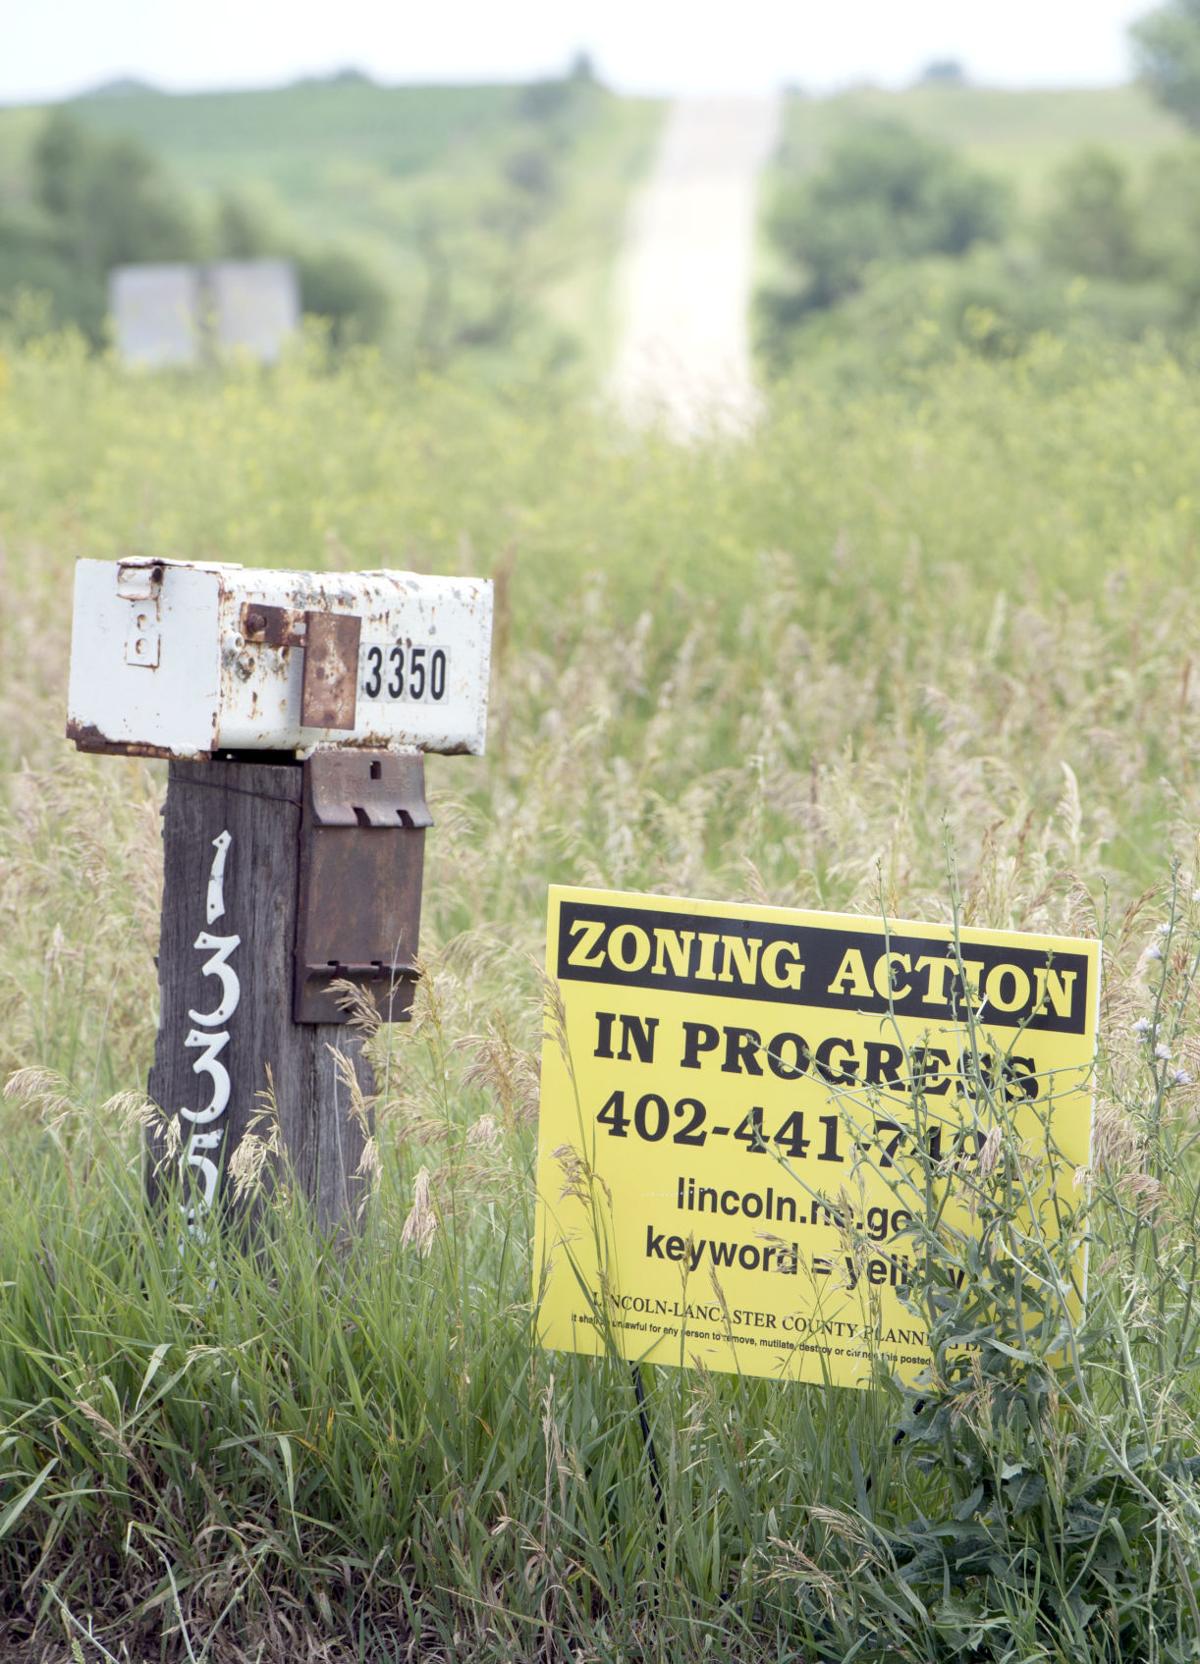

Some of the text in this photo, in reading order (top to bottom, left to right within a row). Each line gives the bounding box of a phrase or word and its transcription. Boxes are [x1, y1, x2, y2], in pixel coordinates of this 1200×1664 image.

[365, 646, 447, 701] 3350
[567, 920, 1078, 1018] ZONING ACTION
[593, 1011, 1040, 1103] IN PROGRESS
[645, 1225, 799, 1274] keyword
[813, 1256, 832, 1276] =
[649, 1323, 662, 1333] for
[663, 1326, 679, 1337] any
[712, 1332, 721, 1341] to
[834, 1347, 844, 1356] or
[900, 1355, 931, 1367] posted
[782, 1315, 859, 1339] COUNTY
